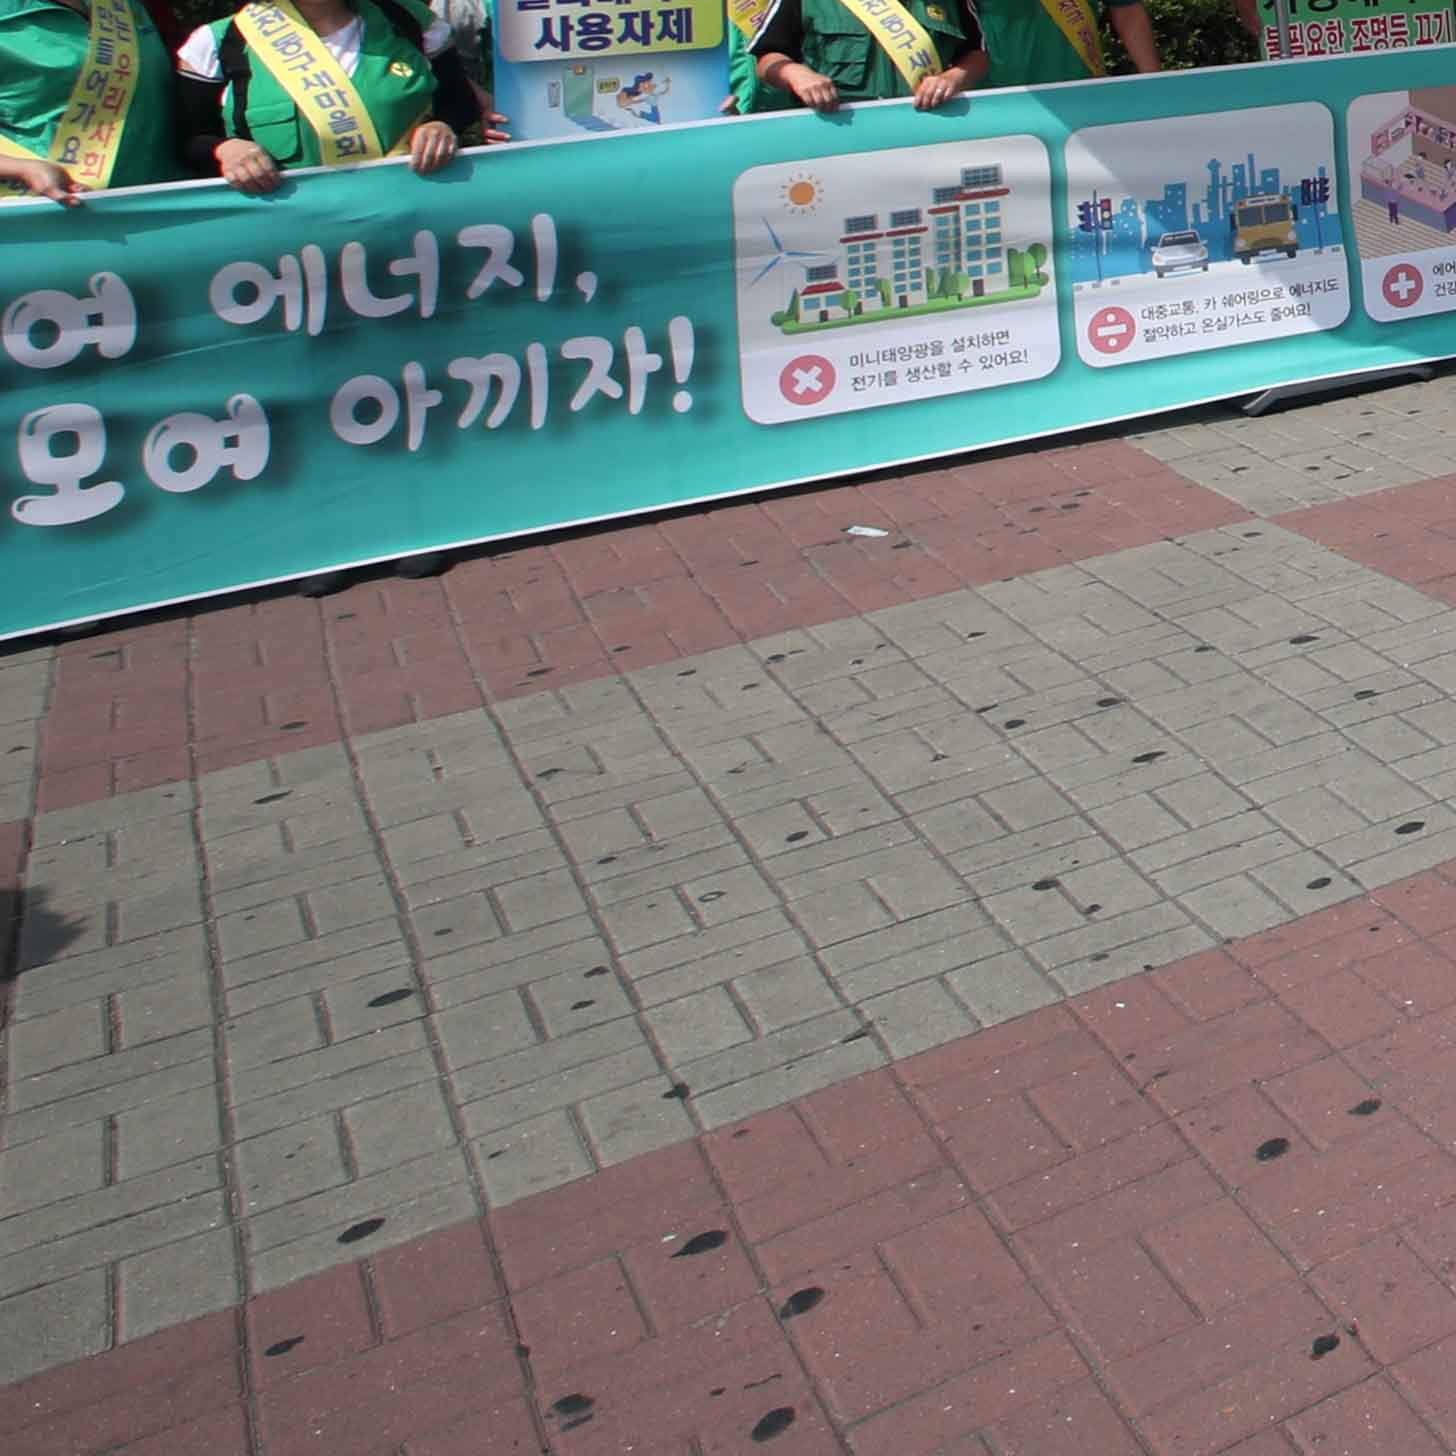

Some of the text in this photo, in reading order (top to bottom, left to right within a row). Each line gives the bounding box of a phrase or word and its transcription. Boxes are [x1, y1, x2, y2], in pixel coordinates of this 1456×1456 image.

[534, 8, 693, 52] 사용자제
[1351, 14, 1409, 52] 조명등
[1415, 8, 1451, 46] 끄기
[209, 213, 601, 336] 에너지,
[1203, 297, 1217, 312] 카
[1222, 287, 1286, 308] 쉐어링으로
[1289, 278, 1339, 297] 에너지도
[1143, 322, 1197, 343] 절약하고
[1202, 309, 1266, 334] 온실가스도
[850, 330, 1010, 368] 미니태양광을 설치하면
[851, 349, 1028, 392] 전기를 생산할 수 있어요!
[11, 316, 696, 526] 모여 아끼자!
